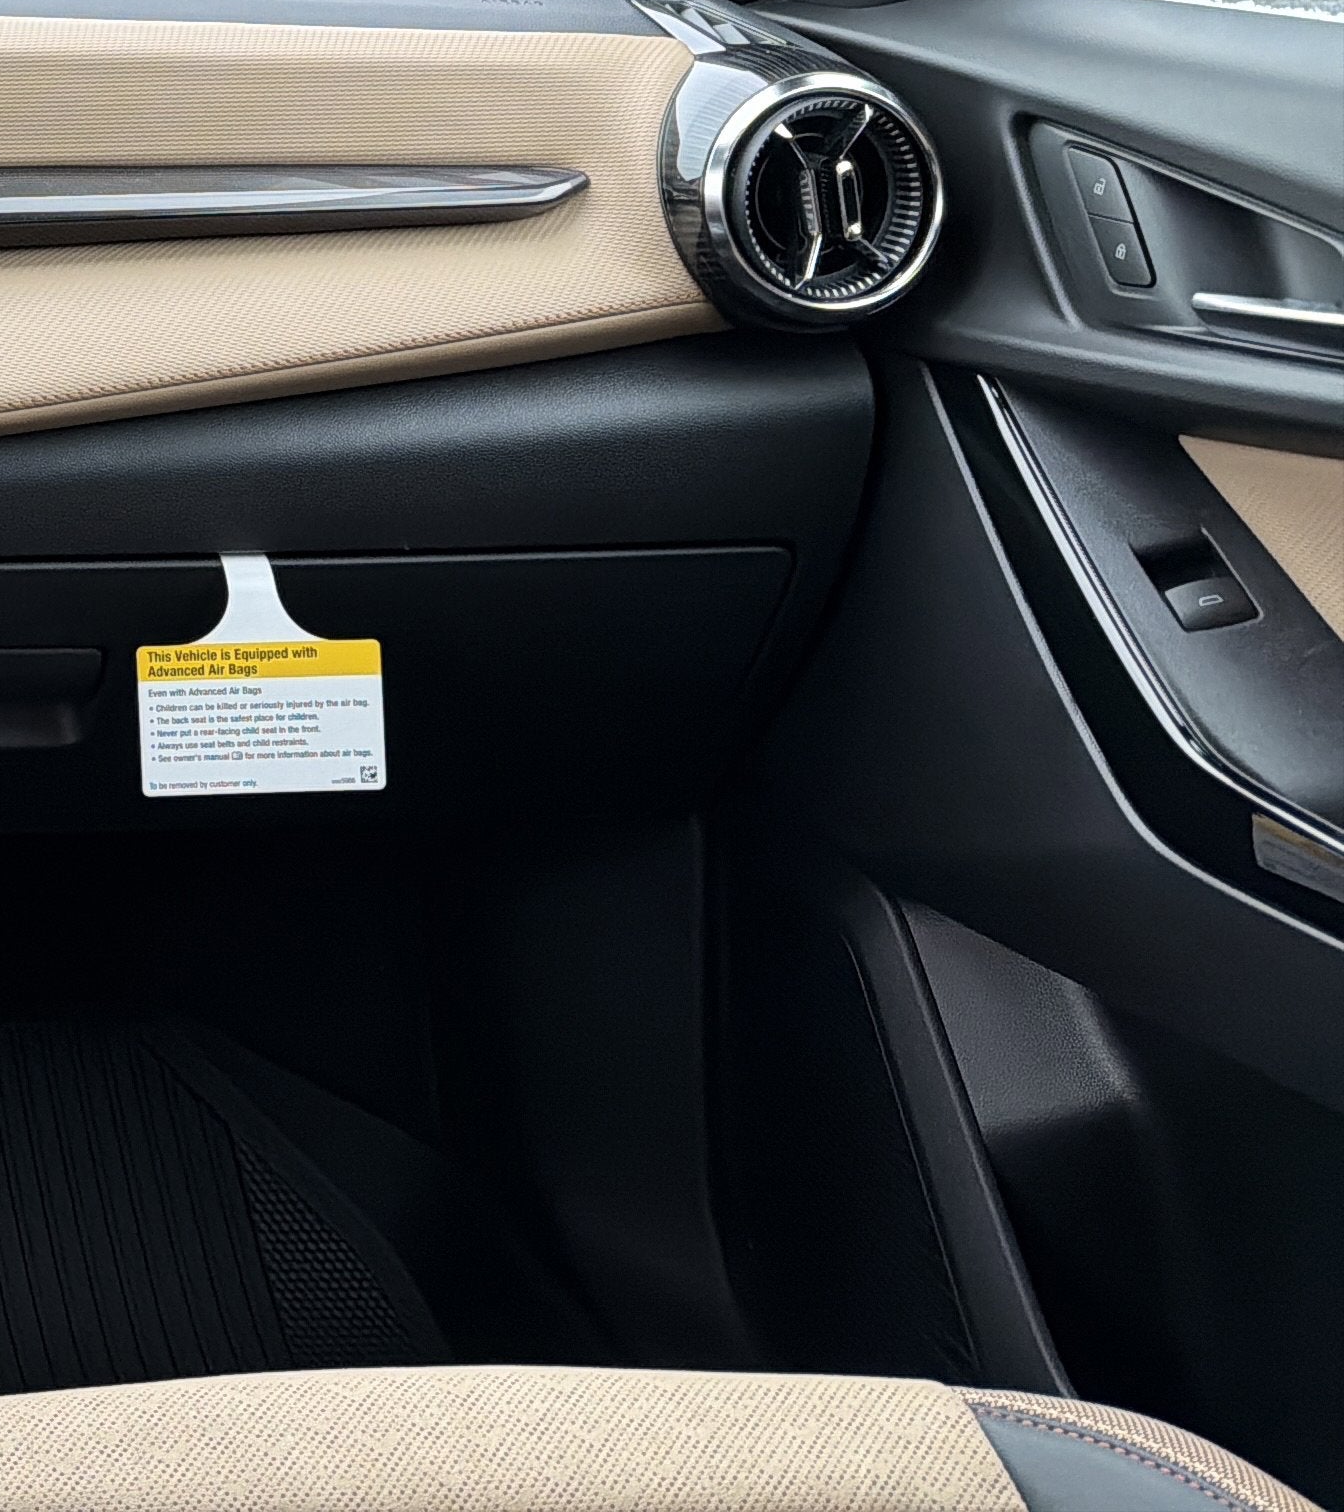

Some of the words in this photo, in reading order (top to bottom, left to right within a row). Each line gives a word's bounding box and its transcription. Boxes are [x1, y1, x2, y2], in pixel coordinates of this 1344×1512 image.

[146, 651, 172, 663] This
[175, 649, 217, 662] Vehicle
[221, 648, 231, 661] is
[234, 647, 289, 663] Equipped
[292, 646, 318, 659] with
[148, 664, 205, 677] Advanced
[208, 663, 225, 676] Air
[228, 663, 258, 677] Bags
[148, 689, 167, 698] Even
[169, 688, 187, 697] with
[188, 687, 227, 696] Advanced
[229, 687, 240, 695] Air
[242, 686, 262, 696] Bags
